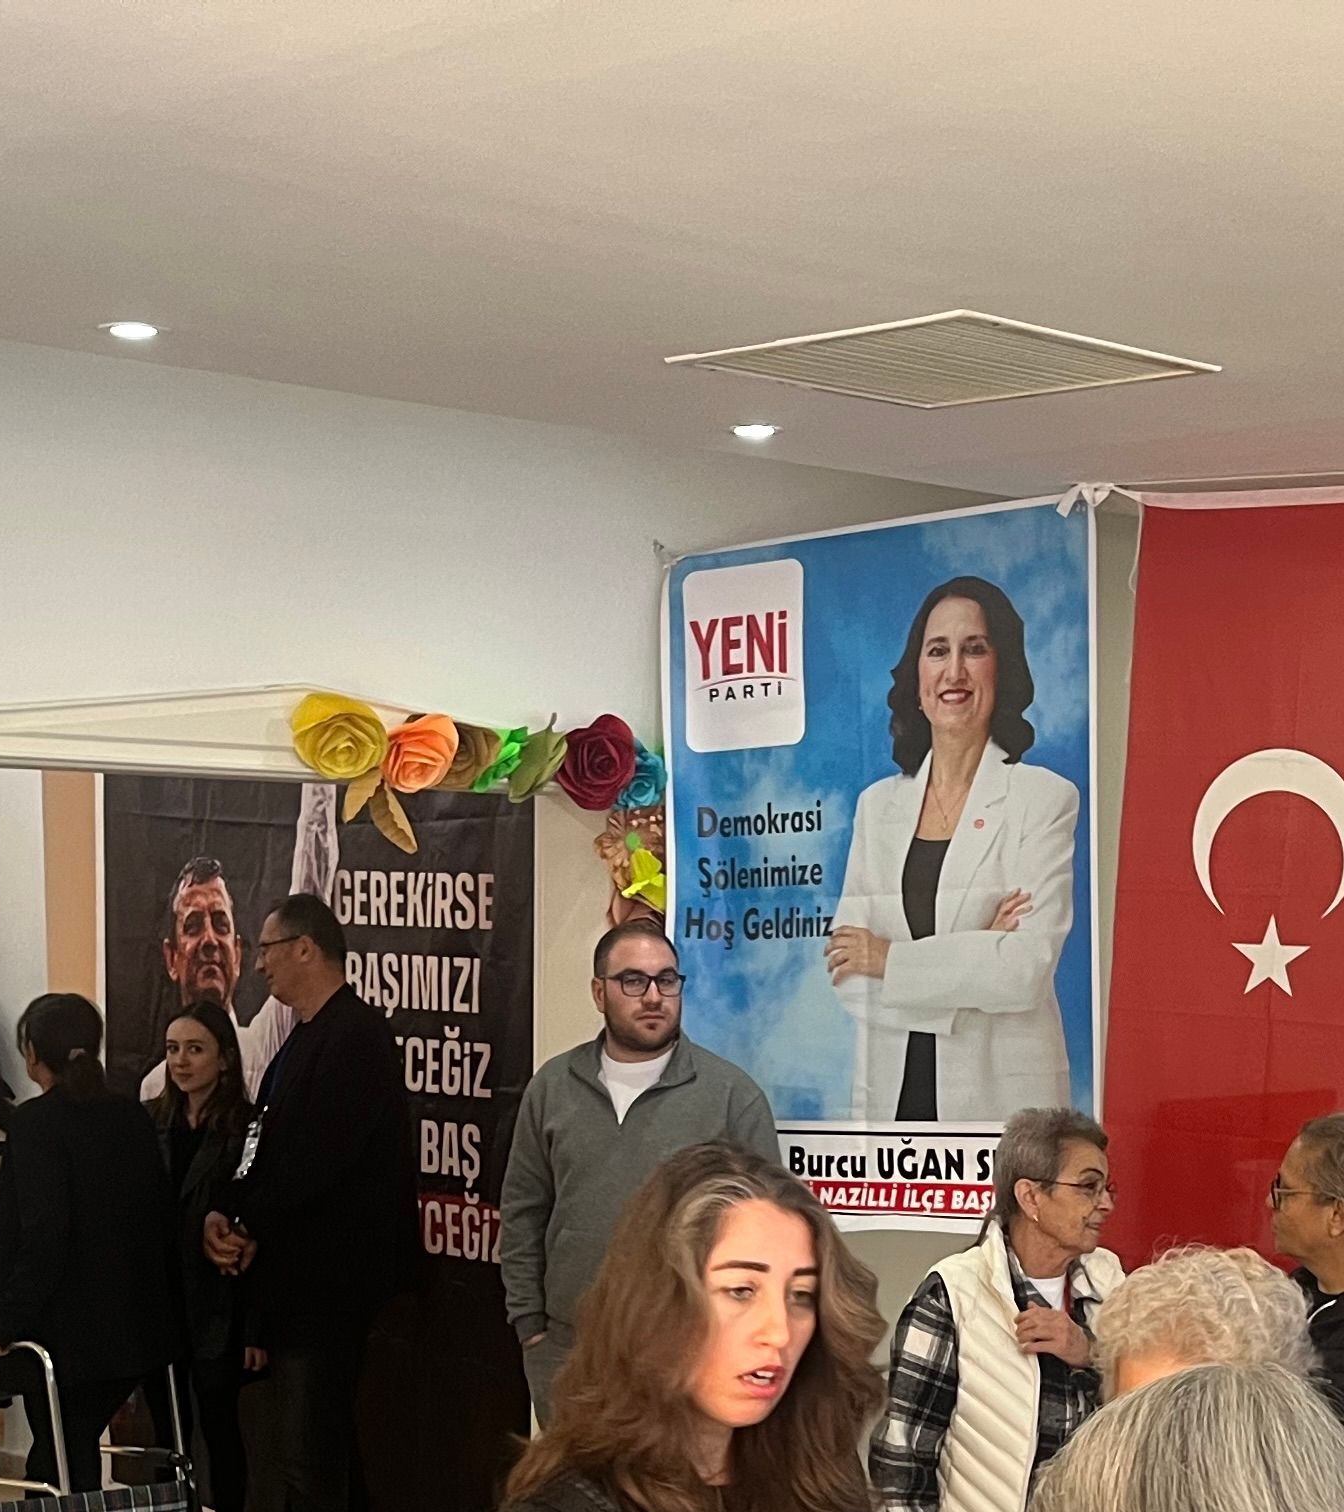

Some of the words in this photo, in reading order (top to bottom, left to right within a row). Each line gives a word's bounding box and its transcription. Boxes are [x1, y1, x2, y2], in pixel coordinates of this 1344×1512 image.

[697, 800, 822, 838] Demokrasi
[698, 855, 823, 898] Şölenimize
[685, 907, 735, 950] Hoş
[743, 907, 834, 941] Geldiniz
[345, 951, 481, 1018] BAŞIMIZI
[395, 1025, 492, 1098] CEĞİZ
[421, 1119, 481, 1188] BAŞ
[789, 1146, 866, 1178] Burcu
[877, 1138, 964, 1180] UĞAN
[819, 1183, 898, 1208] NAZİLLİ
[902, 1184, 945, 1213] İLÇE
